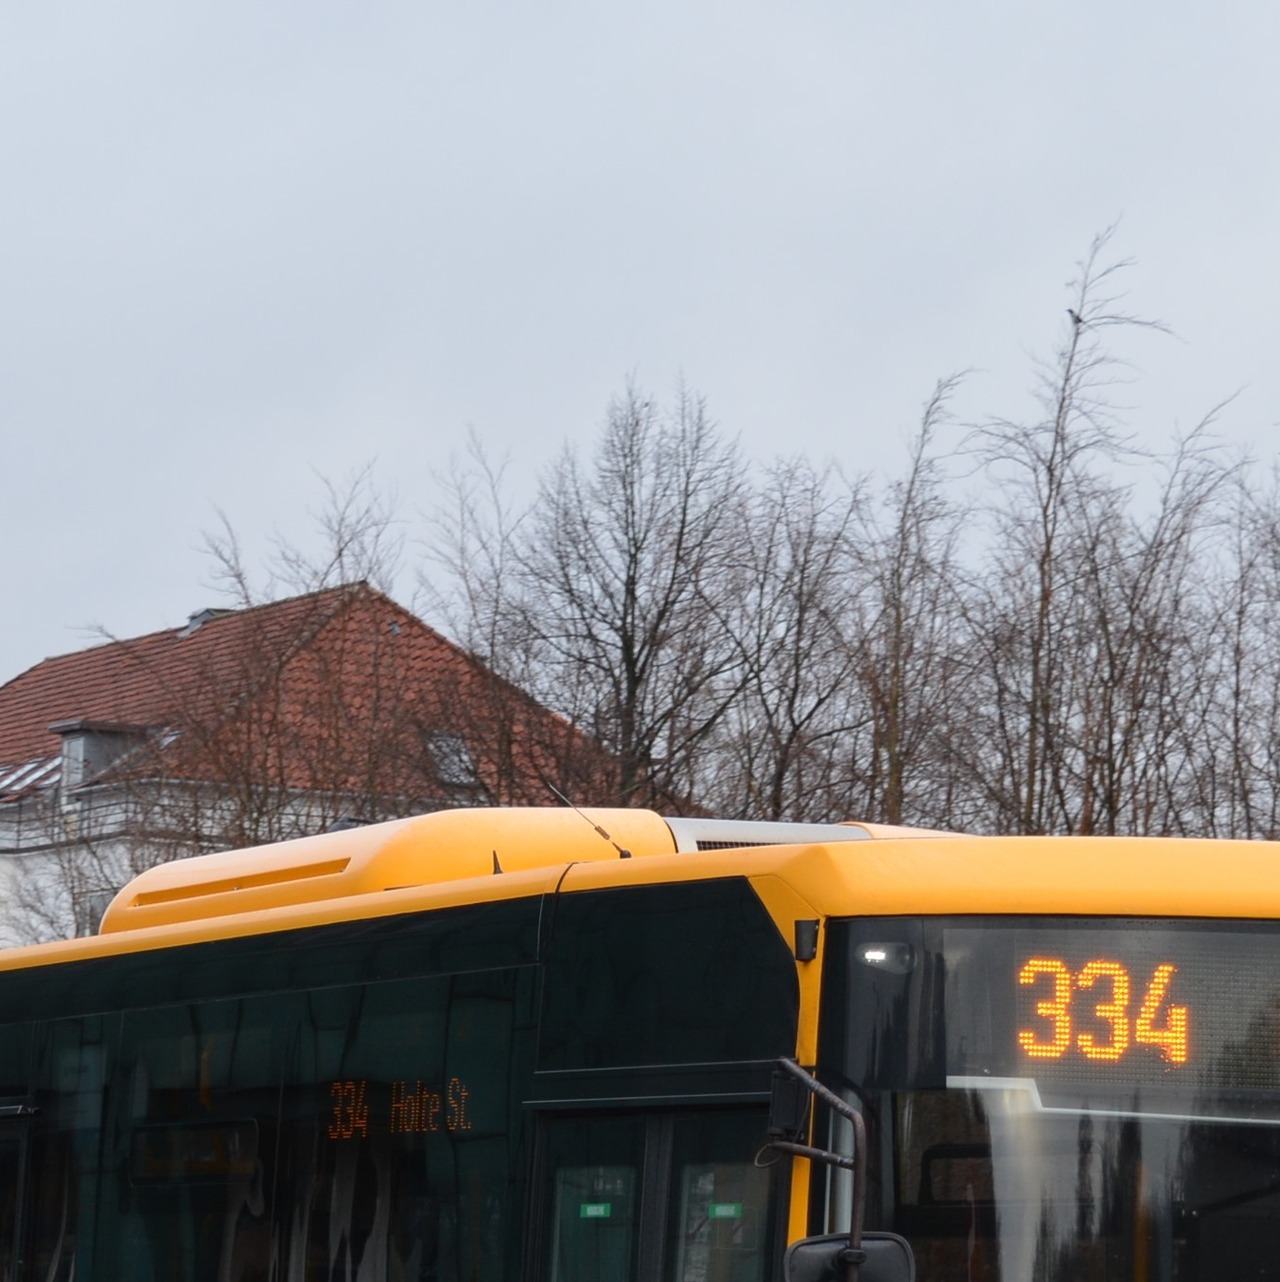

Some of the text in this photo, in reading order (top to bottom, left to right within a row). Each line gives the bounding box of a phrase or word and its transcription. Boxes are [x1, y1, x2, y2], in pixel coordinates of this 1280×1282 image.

[1018, 959, 1187, 1063] 334
[328, 1081, 368, 1138] 334
[390, 1080, 440, 1132] Holte
